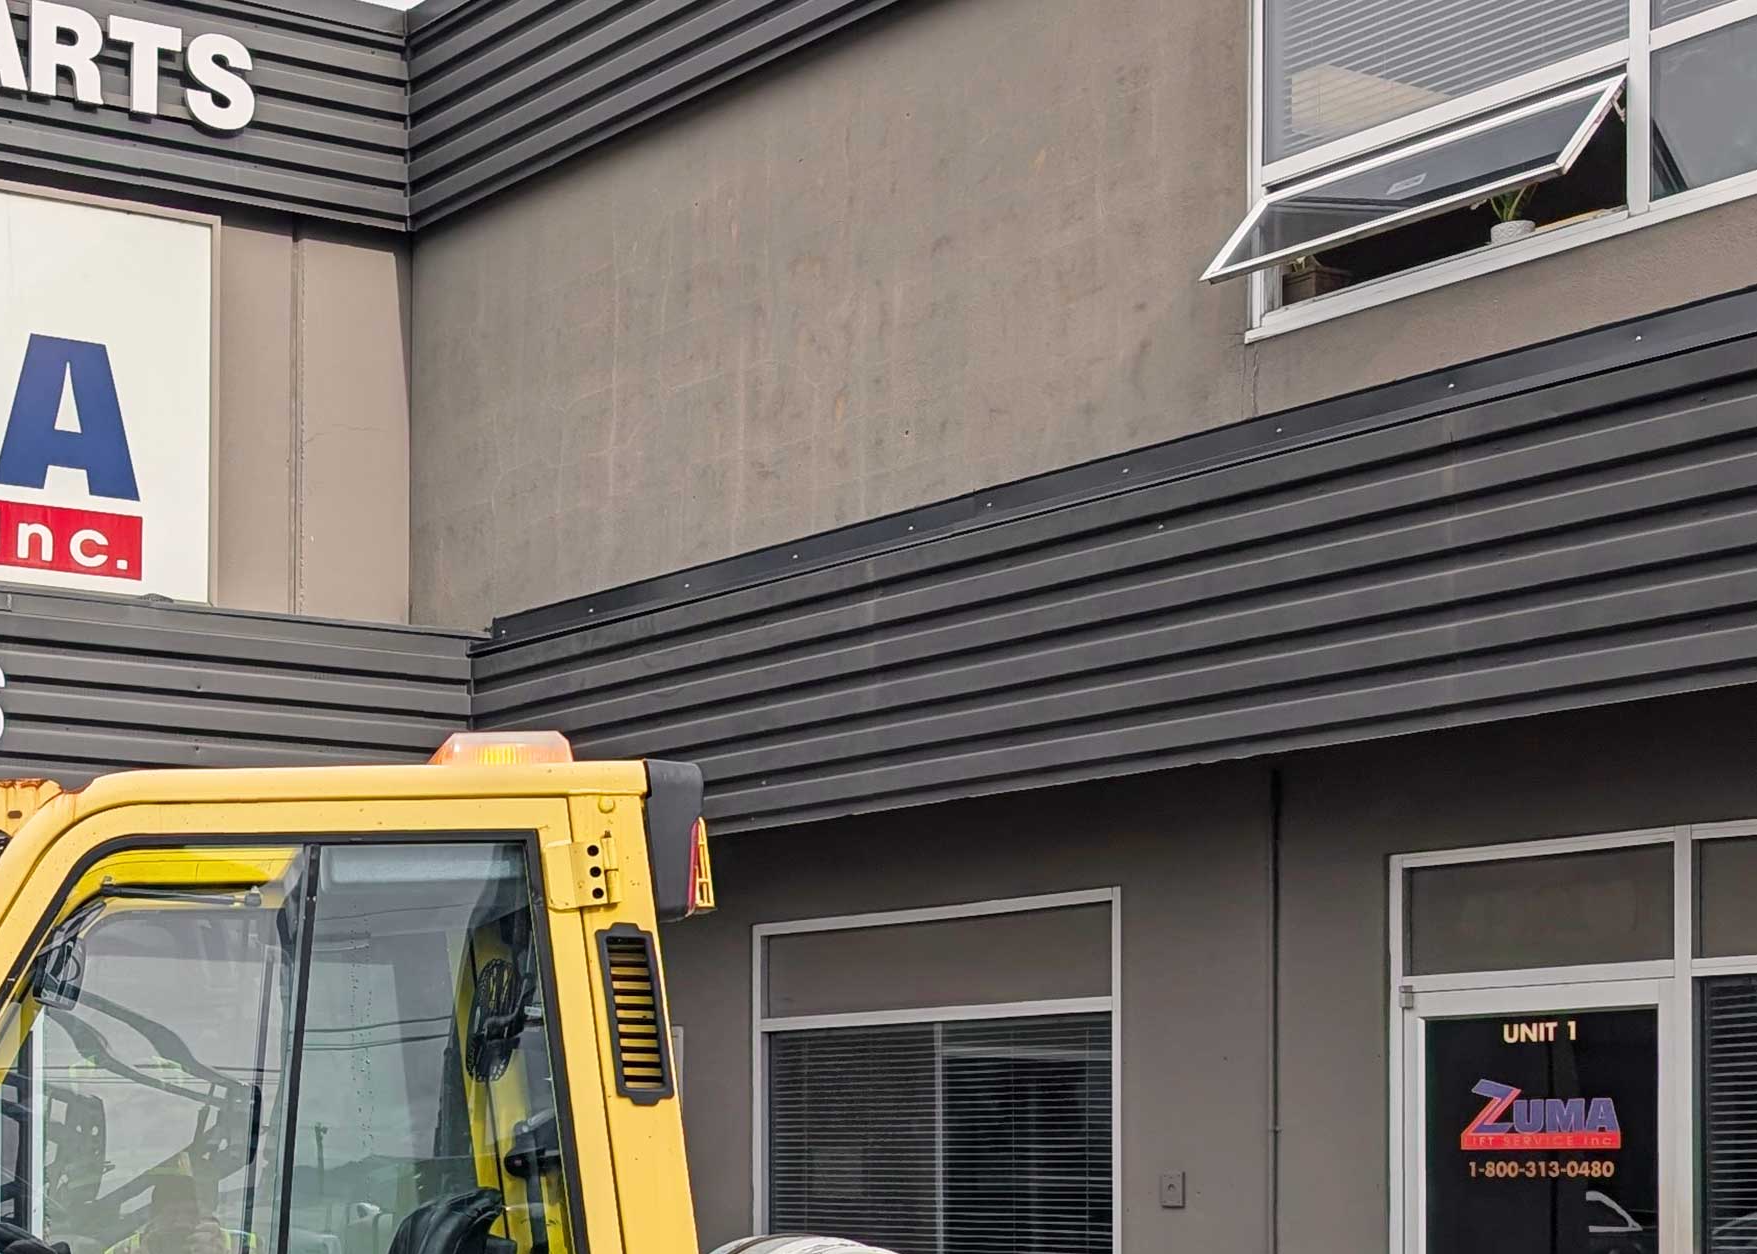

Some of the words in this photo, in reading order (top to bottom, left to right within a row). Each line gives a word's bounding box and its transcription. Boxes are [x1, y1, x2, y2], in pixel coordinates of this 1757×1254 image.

[1503, 1021, 1559, 1044] UNIT
[1566, 1020, 1577, 1041] 1
[1461, 1078, 1621, 1134] ZUMA
[1503, 1135, 1575, 1147] SERVICE
[1468, 1160, 1615, 1178] 1-800-313-0480
